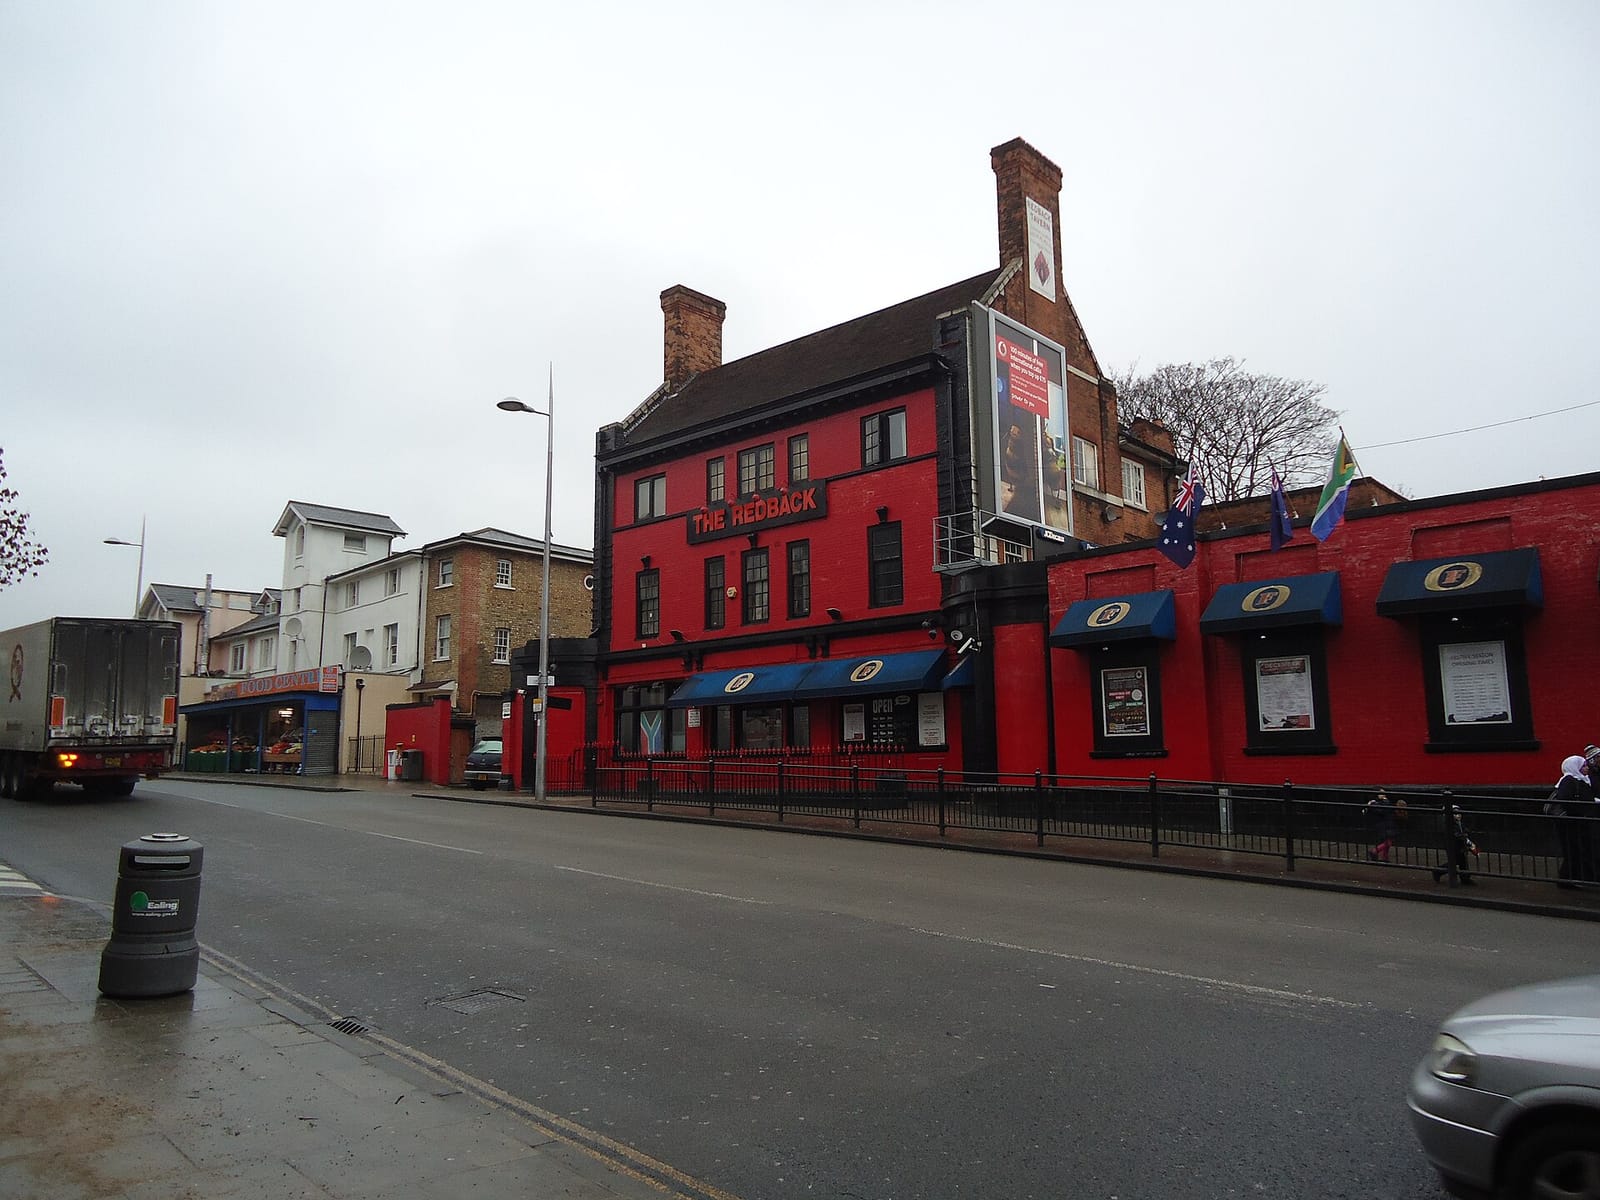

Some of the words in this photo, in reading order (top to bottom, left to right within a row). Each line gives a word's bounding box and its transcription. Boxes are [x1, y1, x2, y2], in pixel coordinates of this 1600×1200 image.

[693, 509, 726, 534] THE
[731, 487, 817, 527] REDBACK
[240, 679, 273, 694] FOOD
[872, 698, 893, 714] OPEN
[147, 901, 178, 910] Ealing
